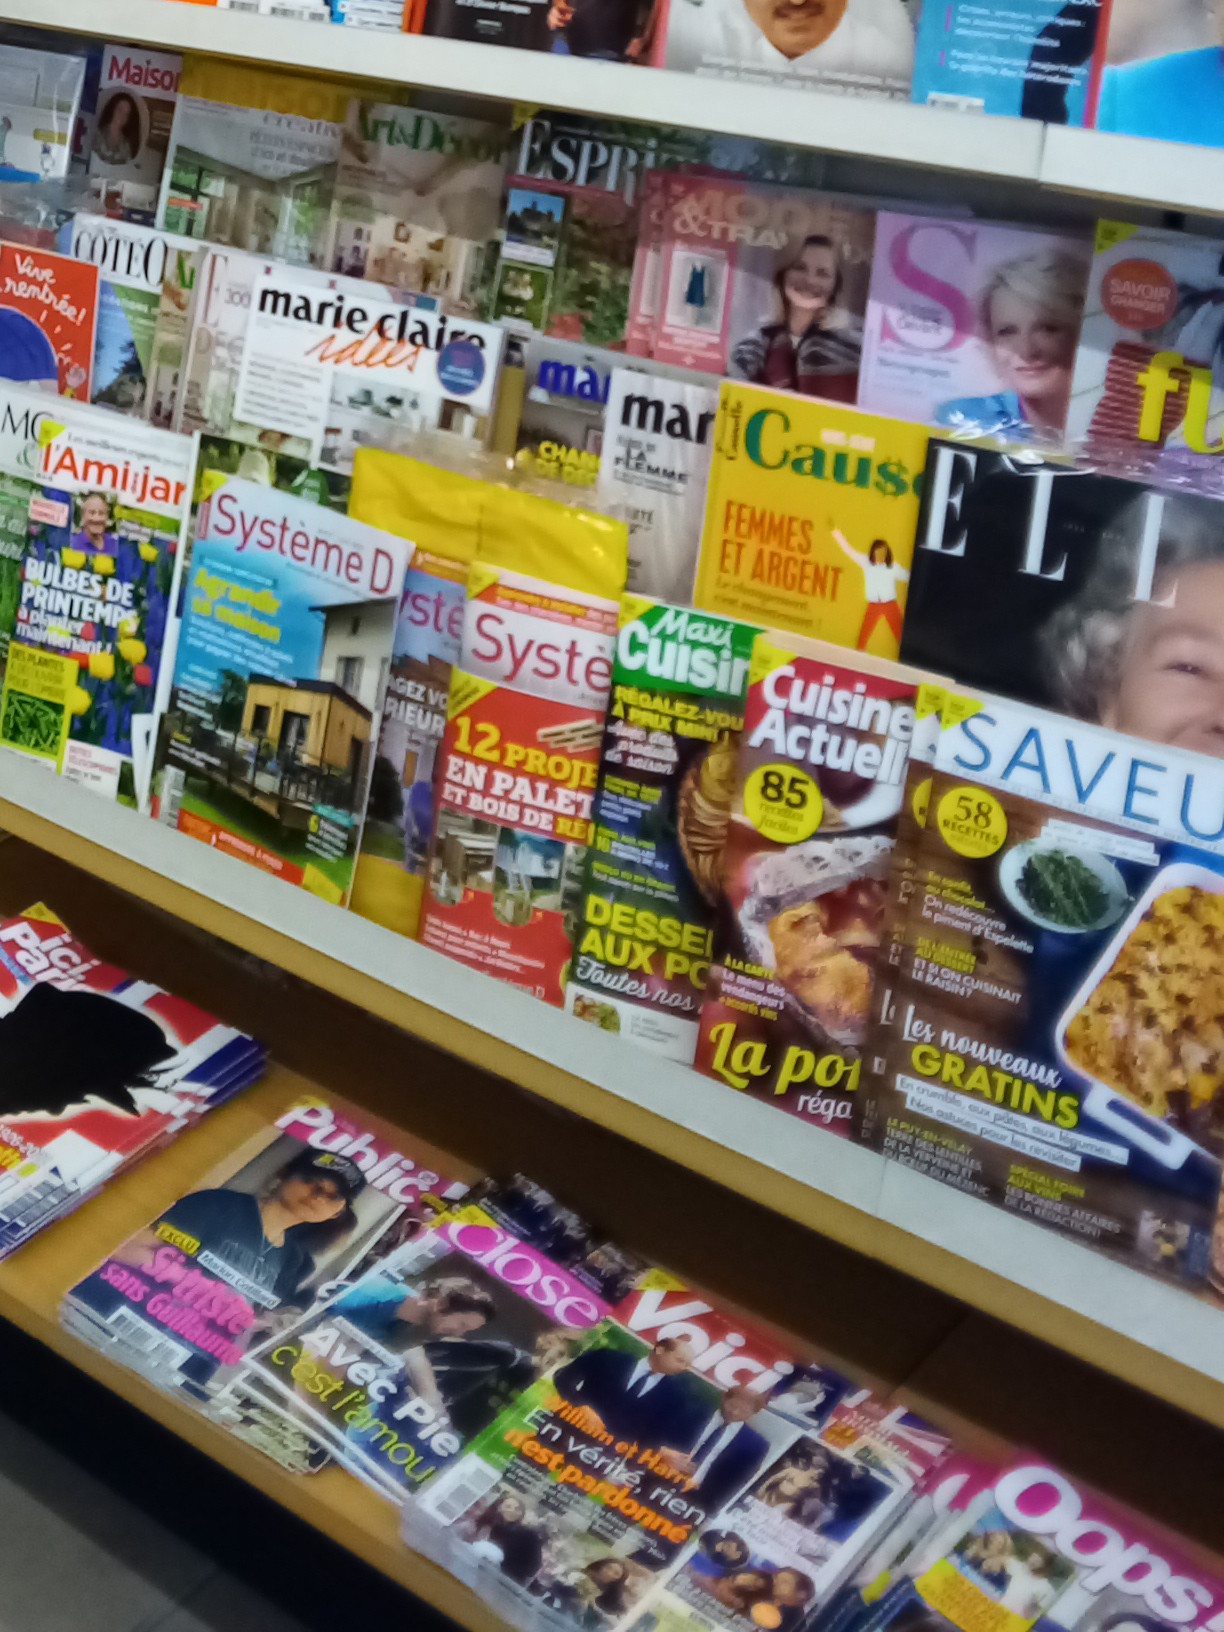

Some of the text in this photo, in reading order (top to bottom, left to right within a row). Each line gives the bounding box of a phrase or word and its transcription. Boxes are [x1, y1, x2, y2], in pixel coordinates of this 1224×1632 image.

[258, 283, 370, 329] marie
[1108, 280, 1171, 307] SAVOIR
[211, 492, 394, 596] Système D
[723, 499, 815, 554] FEMMES
[24, 556, 135, 605] BULBES DE
[719, 539, 843, 603] ET ARGENT
[649, 608, 735, 647] Maxi
[454, 717, 500, 755] 12
[446, 753, 485, 795] EN
[759, 769, 809, 809] 85
[442, 781, 466, 805] ET
[523, 810, 553, 833] DE
[952, 795, 993, 829] 58
[709, 1021, 771, 1090] La
[903, 1003, 1062, 1090] Les nouveaux
[910, 1044, 1080, 1130] GRATINS
[300, 1328, 393, 1404] Avec
[522, 1405, 564, 1443] En
[647, 1484, 708, 1527] rien
